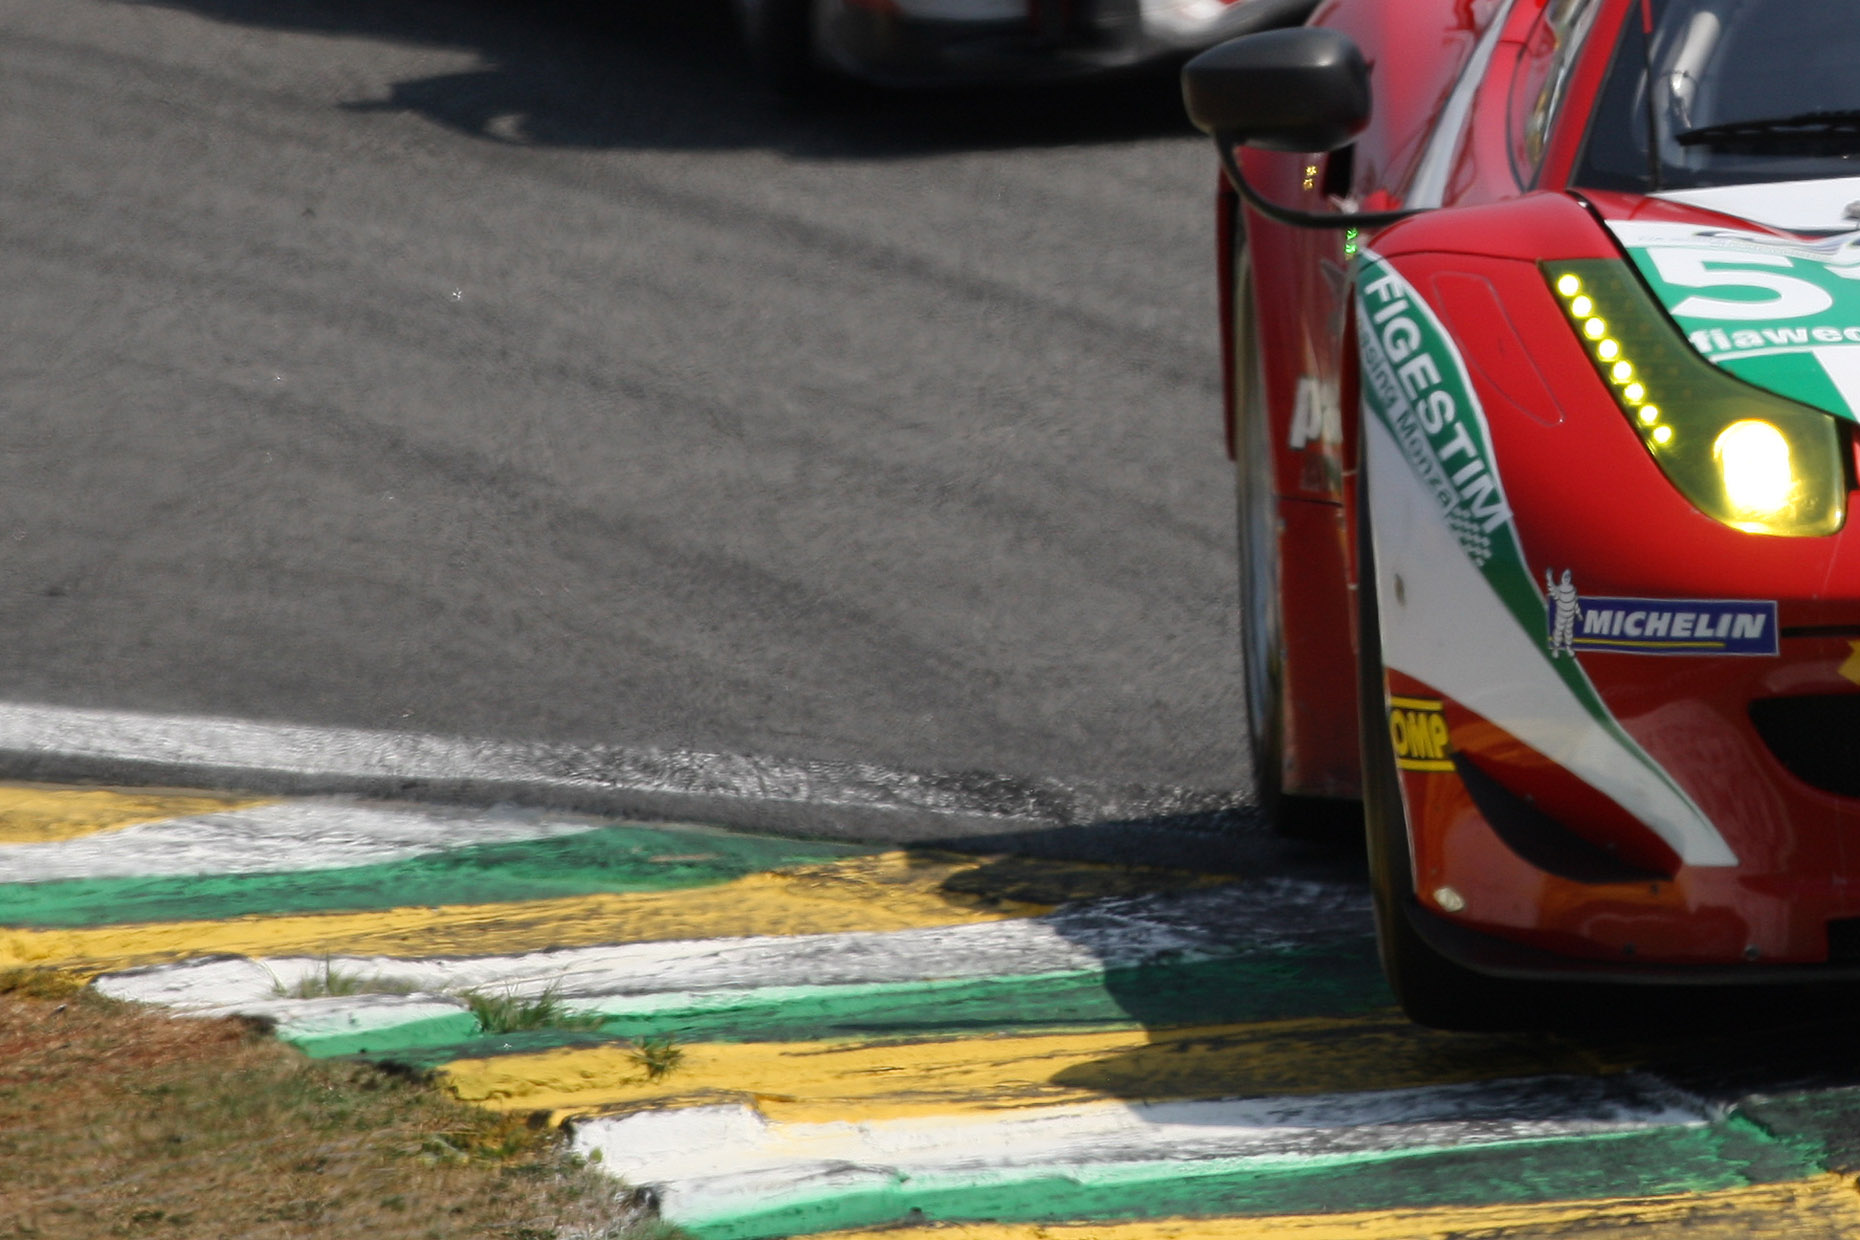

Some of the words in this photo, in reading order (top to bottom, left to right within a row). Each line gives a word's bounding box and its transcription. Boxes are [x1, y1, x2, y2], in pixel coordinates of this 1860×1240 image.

[1363, 272, 1513, 536] FIGESTIM
[1582, 608, 1767, 640] MICHELIN
[1389, 709, 1450, 759] OMP
